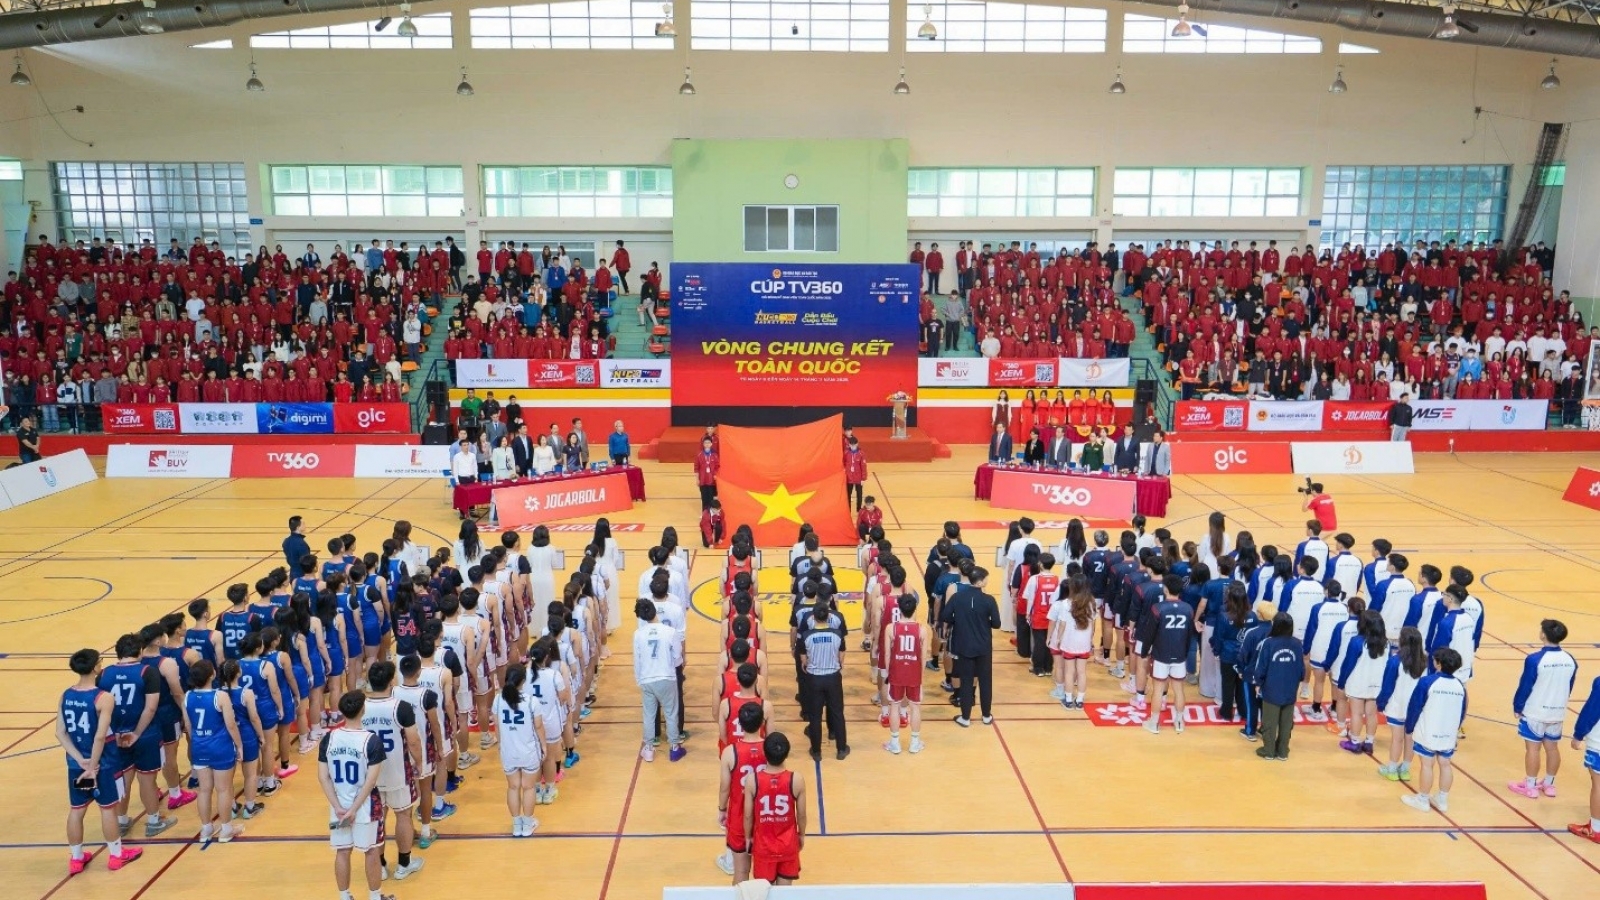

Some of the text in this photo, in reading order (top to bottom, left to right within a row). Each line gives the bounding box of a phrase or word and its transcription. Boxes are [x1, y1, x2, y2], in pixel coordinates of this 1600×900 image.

[751, 279, 842, 294] CÚP TV360
[702, 338, 895, 356] VÒNG CHUNG KẾT
[735, 358, 861, 374] TOÀN QUỐC
[952, 369, 969, 378] BUV
[1000, 369, 1023, 377] XEM
[540, 371, 563, 379] XEM
[116, 416, 140, 424] XEM
[290, 413, 327, 426] digimi
[1187, 412, 1211, 422] XEM
[1343, 410, 1388, 422] JOGARBOLA
[167, 459, 188, 467] BUV
[266, 452, 320, 469] TV360
[544, 488, 606, 510] JOGARBOLA
[1032, 483, 1092, 506] TV360
[397, 620, 419, 636] 54
[1165, 614, 1187, 628] 22
[648, 640, 658, 658] 7
[898, 635, 915, 652] 10
[112, 684, 136, 705] 47
[65, 710, 90, 734] 34
[195, 708, 206, 729] 7
[502, 710, 524, 724] 12
[370, 730, 394, 752] 5
[333, 760, 359, 784] 10
[760, 794, 790, 816] 15
